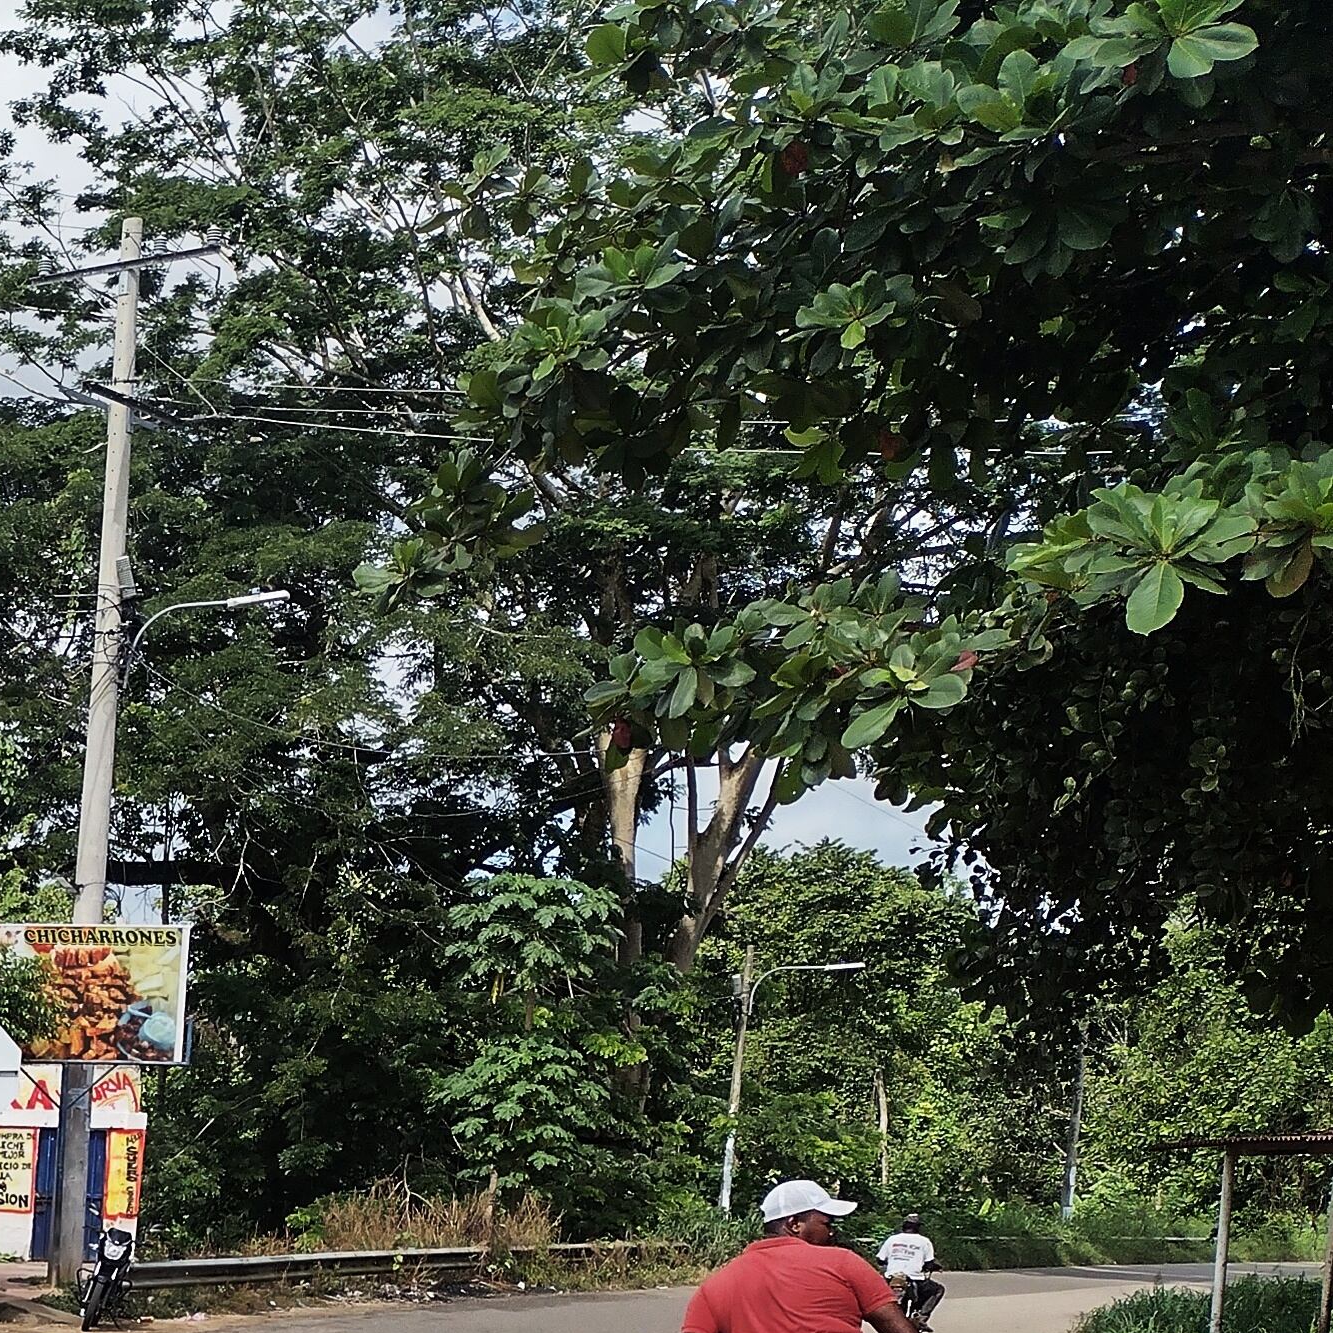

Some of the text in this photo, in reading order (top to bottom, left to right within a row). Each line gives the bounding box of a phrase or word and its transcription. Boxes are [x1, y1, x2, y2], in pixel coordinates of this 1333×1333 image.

[24, 929, 177, 946] CHICHARRONES
[10, 1079, 54, 1110] A
[0, 1172, 13, 1181] LA
